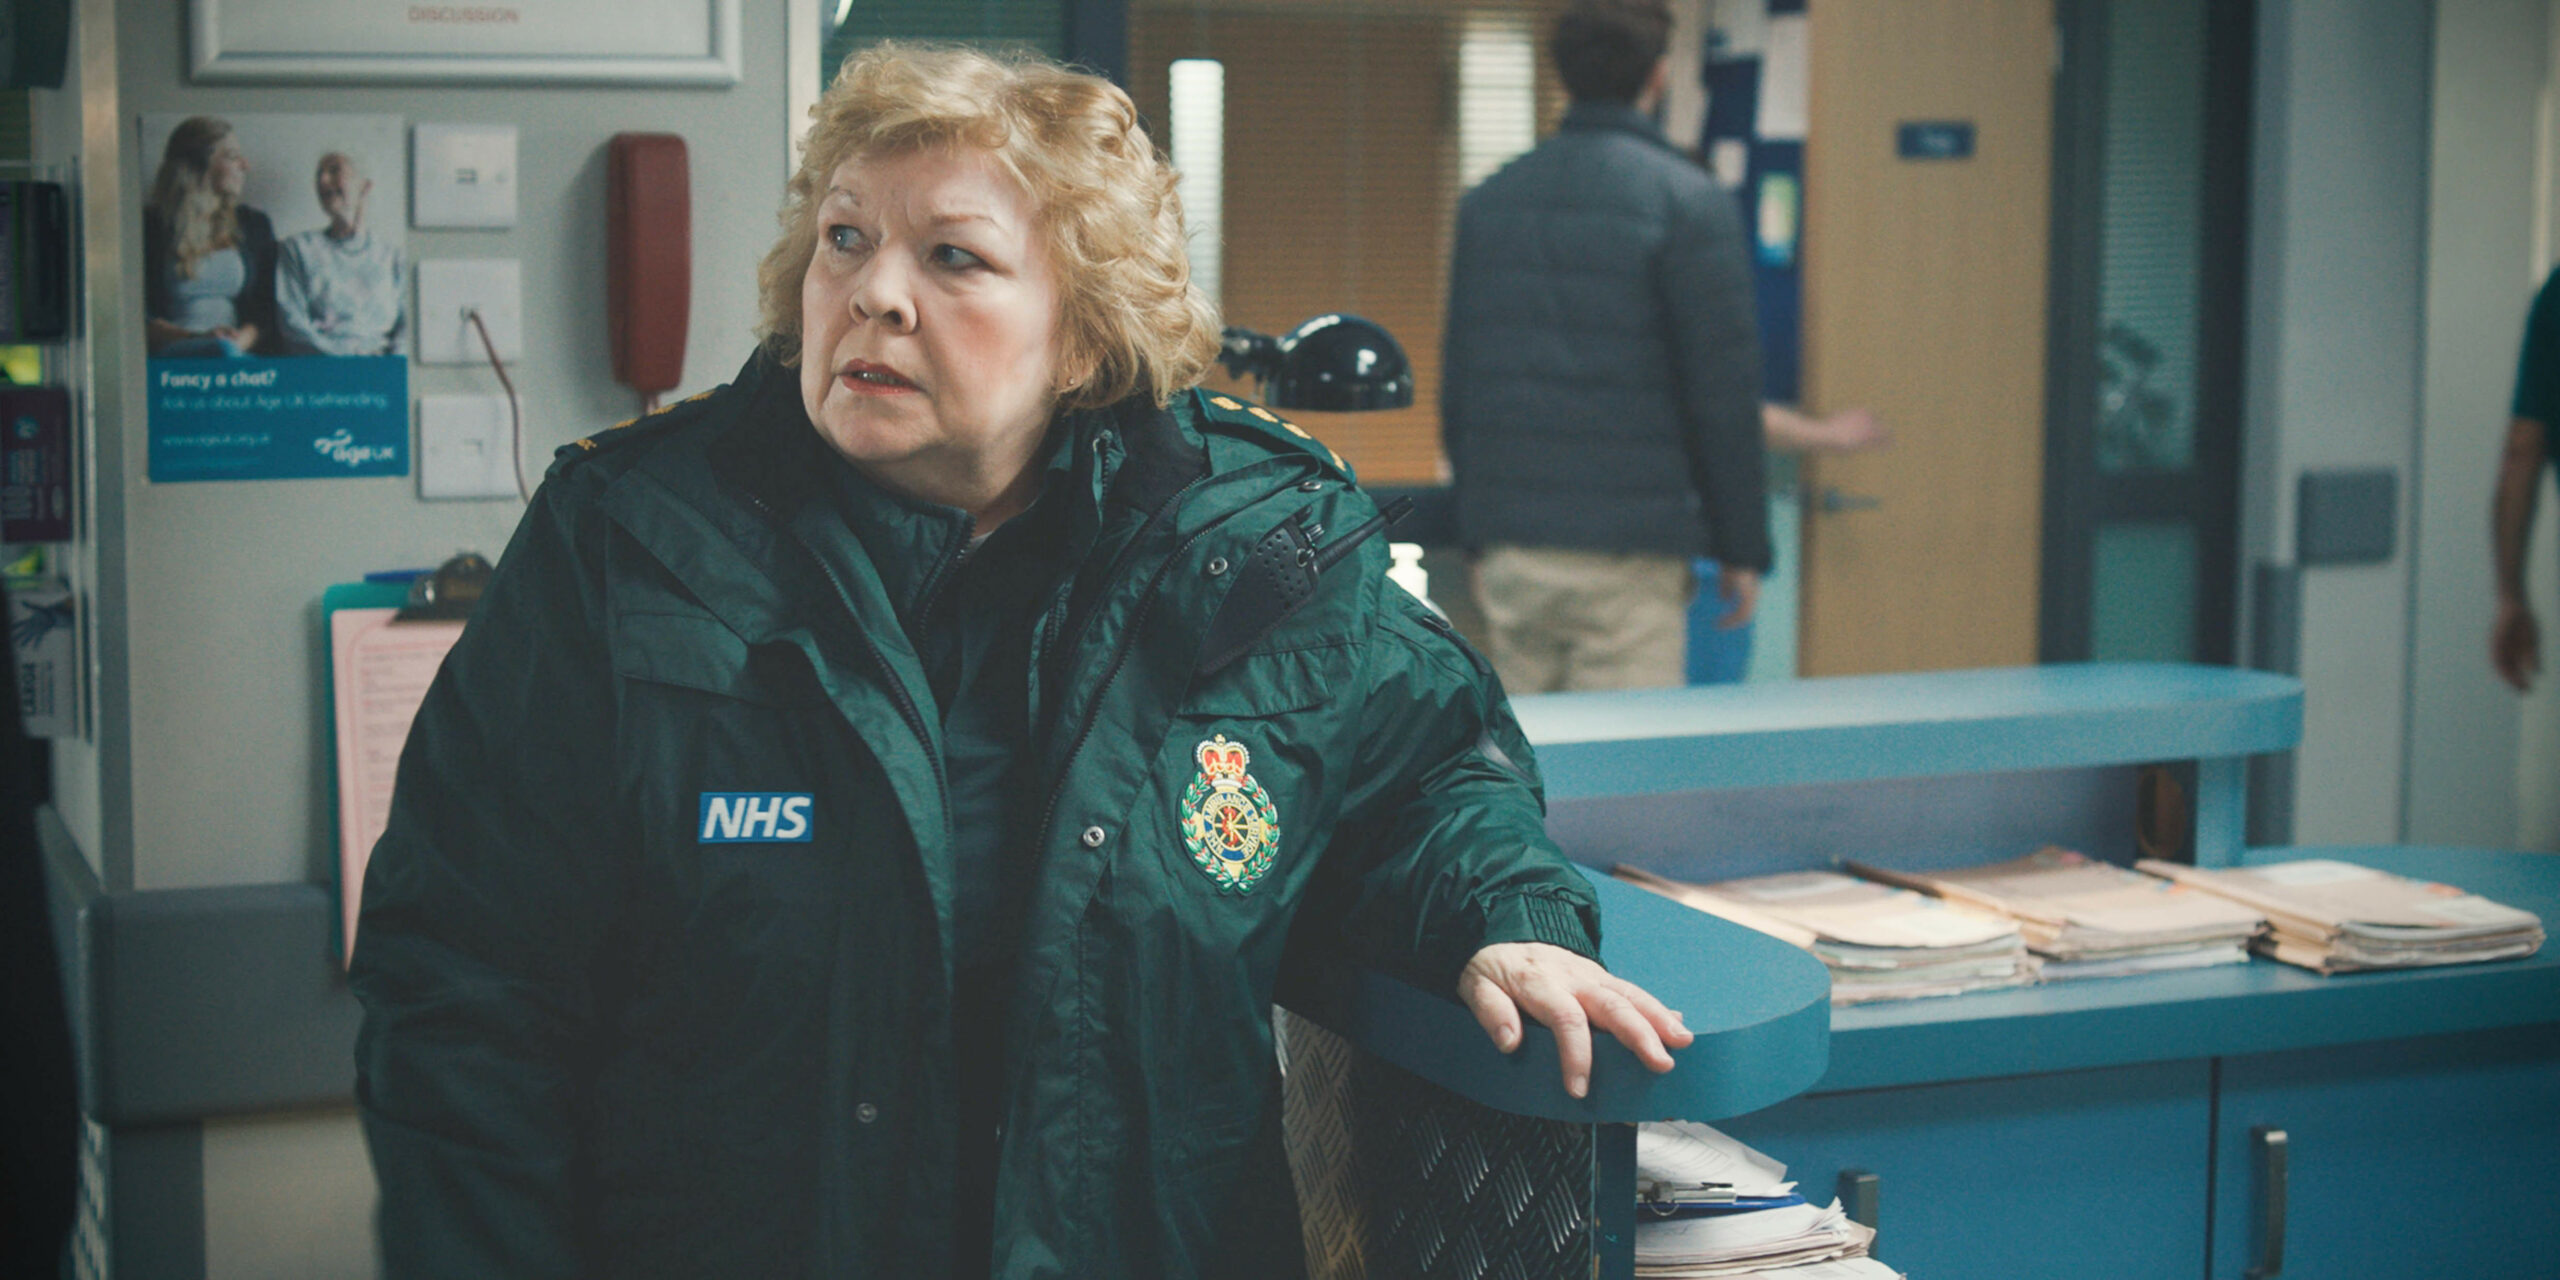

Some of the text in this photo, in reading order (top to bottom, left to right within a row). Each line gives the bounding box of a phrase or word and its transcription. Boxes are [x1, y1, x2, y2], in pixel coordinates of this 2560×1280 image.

[408, 6, 519, 23] DISCUSSION
[160, 368, 277, 391] Fancy a chat?
[333, 444, 370, 469] age
[703, 796, 811, 839] NHS
